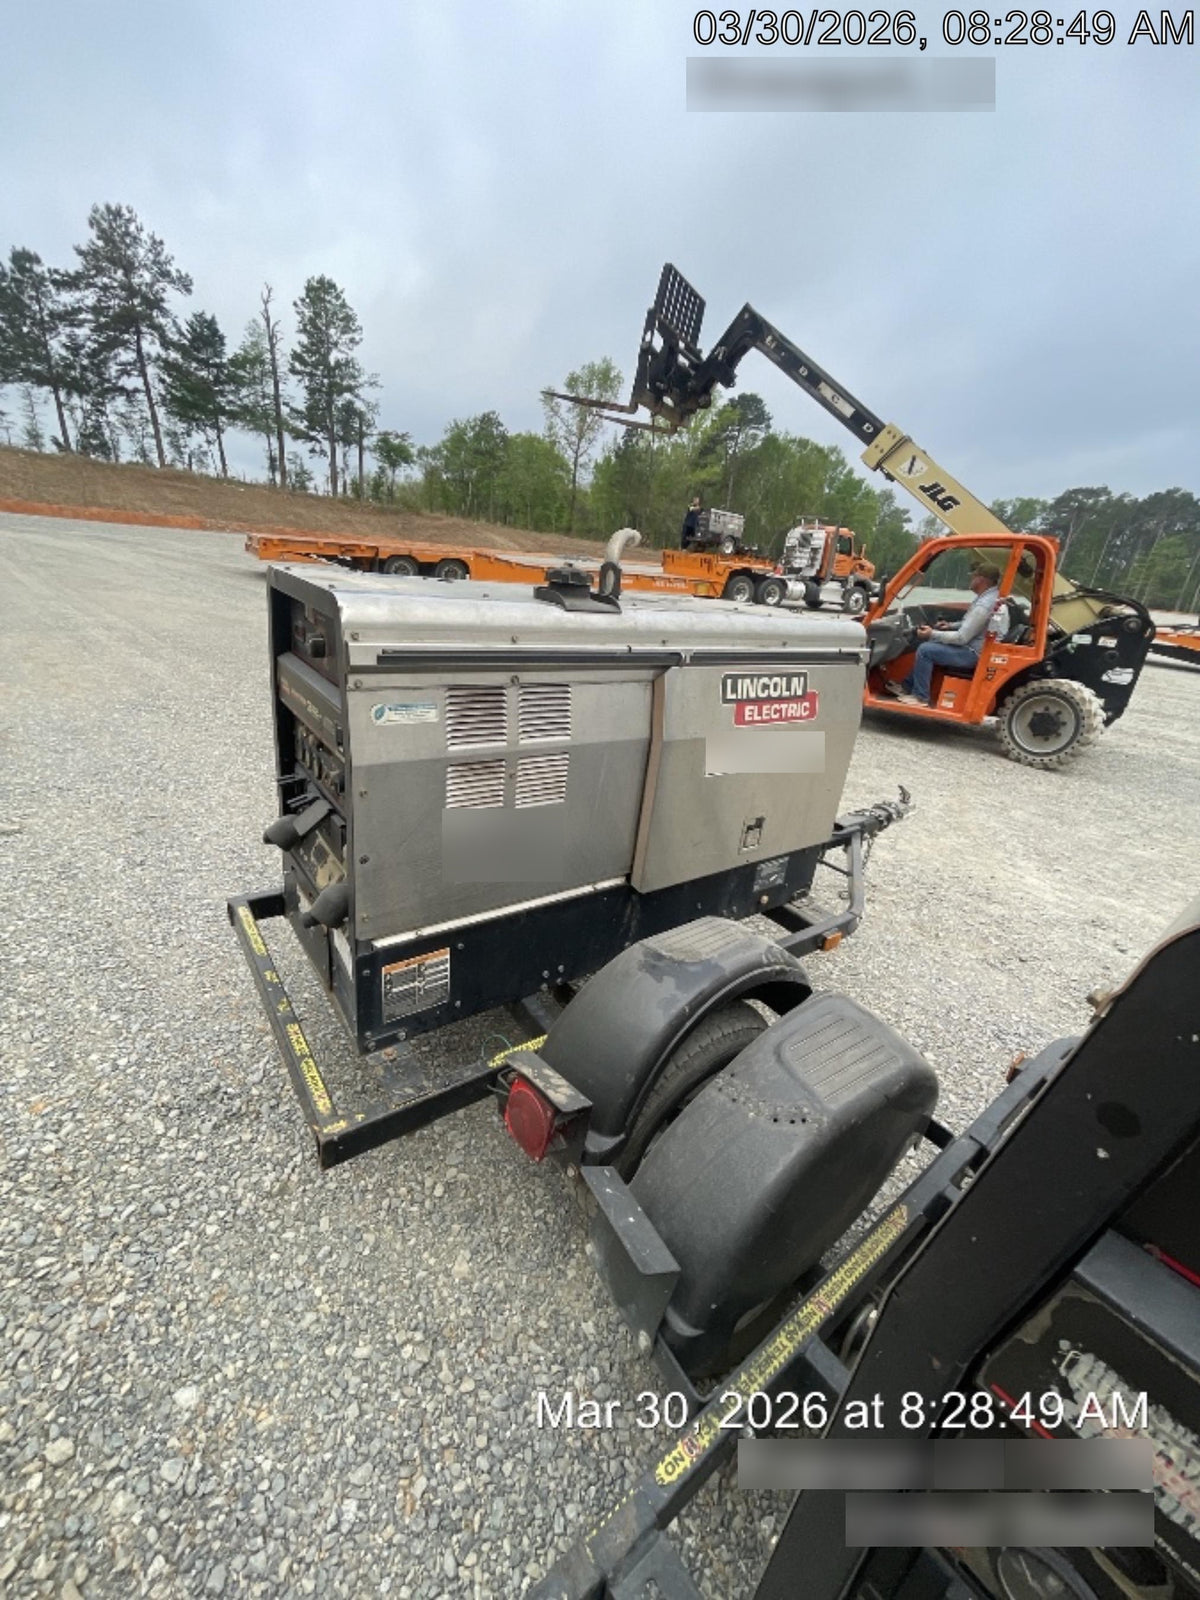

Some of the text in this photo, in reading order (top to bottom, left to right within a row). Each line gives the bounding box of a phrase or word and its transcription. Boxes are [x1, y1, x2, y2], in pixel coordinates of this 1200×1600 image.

[918, 481, 961, 513] JLG
[725, 676, 805, 700] LINCOLN
[743, 701, 810, 721] ELECTRIC
[662, 1450, 687, 1477] NO
